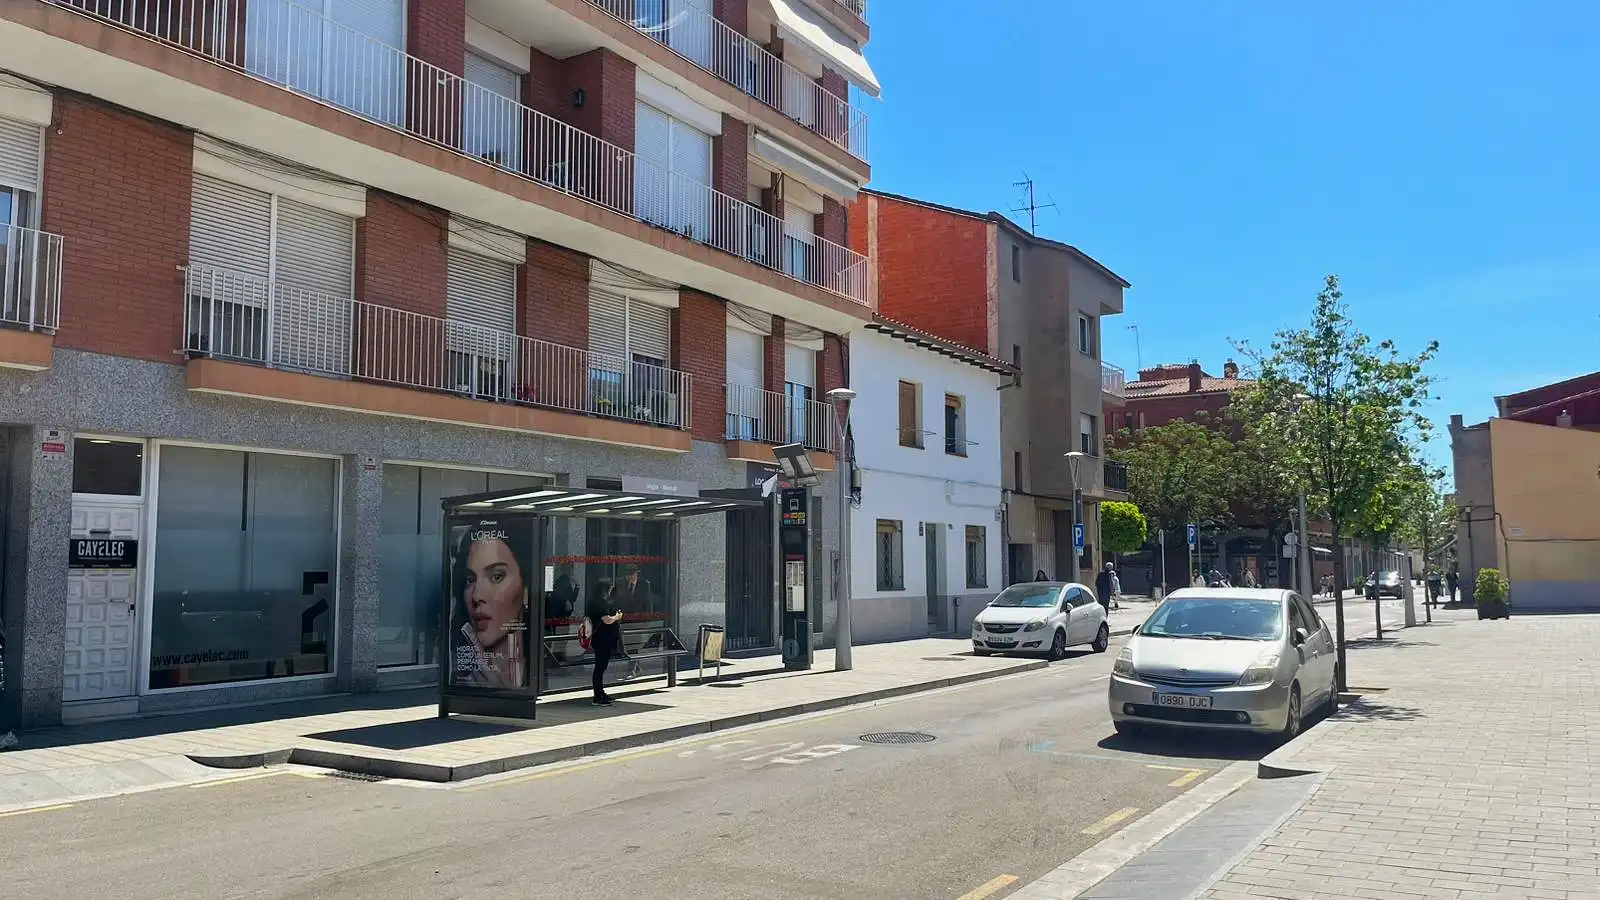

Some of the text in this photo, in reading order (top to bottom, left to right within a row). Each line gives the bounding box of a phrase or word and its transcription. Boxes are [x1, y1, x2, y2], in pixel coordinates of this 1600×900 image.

[1075, 527, 1082, 543] P
[78, 540, 125, 557] CAYELEC
[1160, 695, 1207, 708] 0890 DJC
